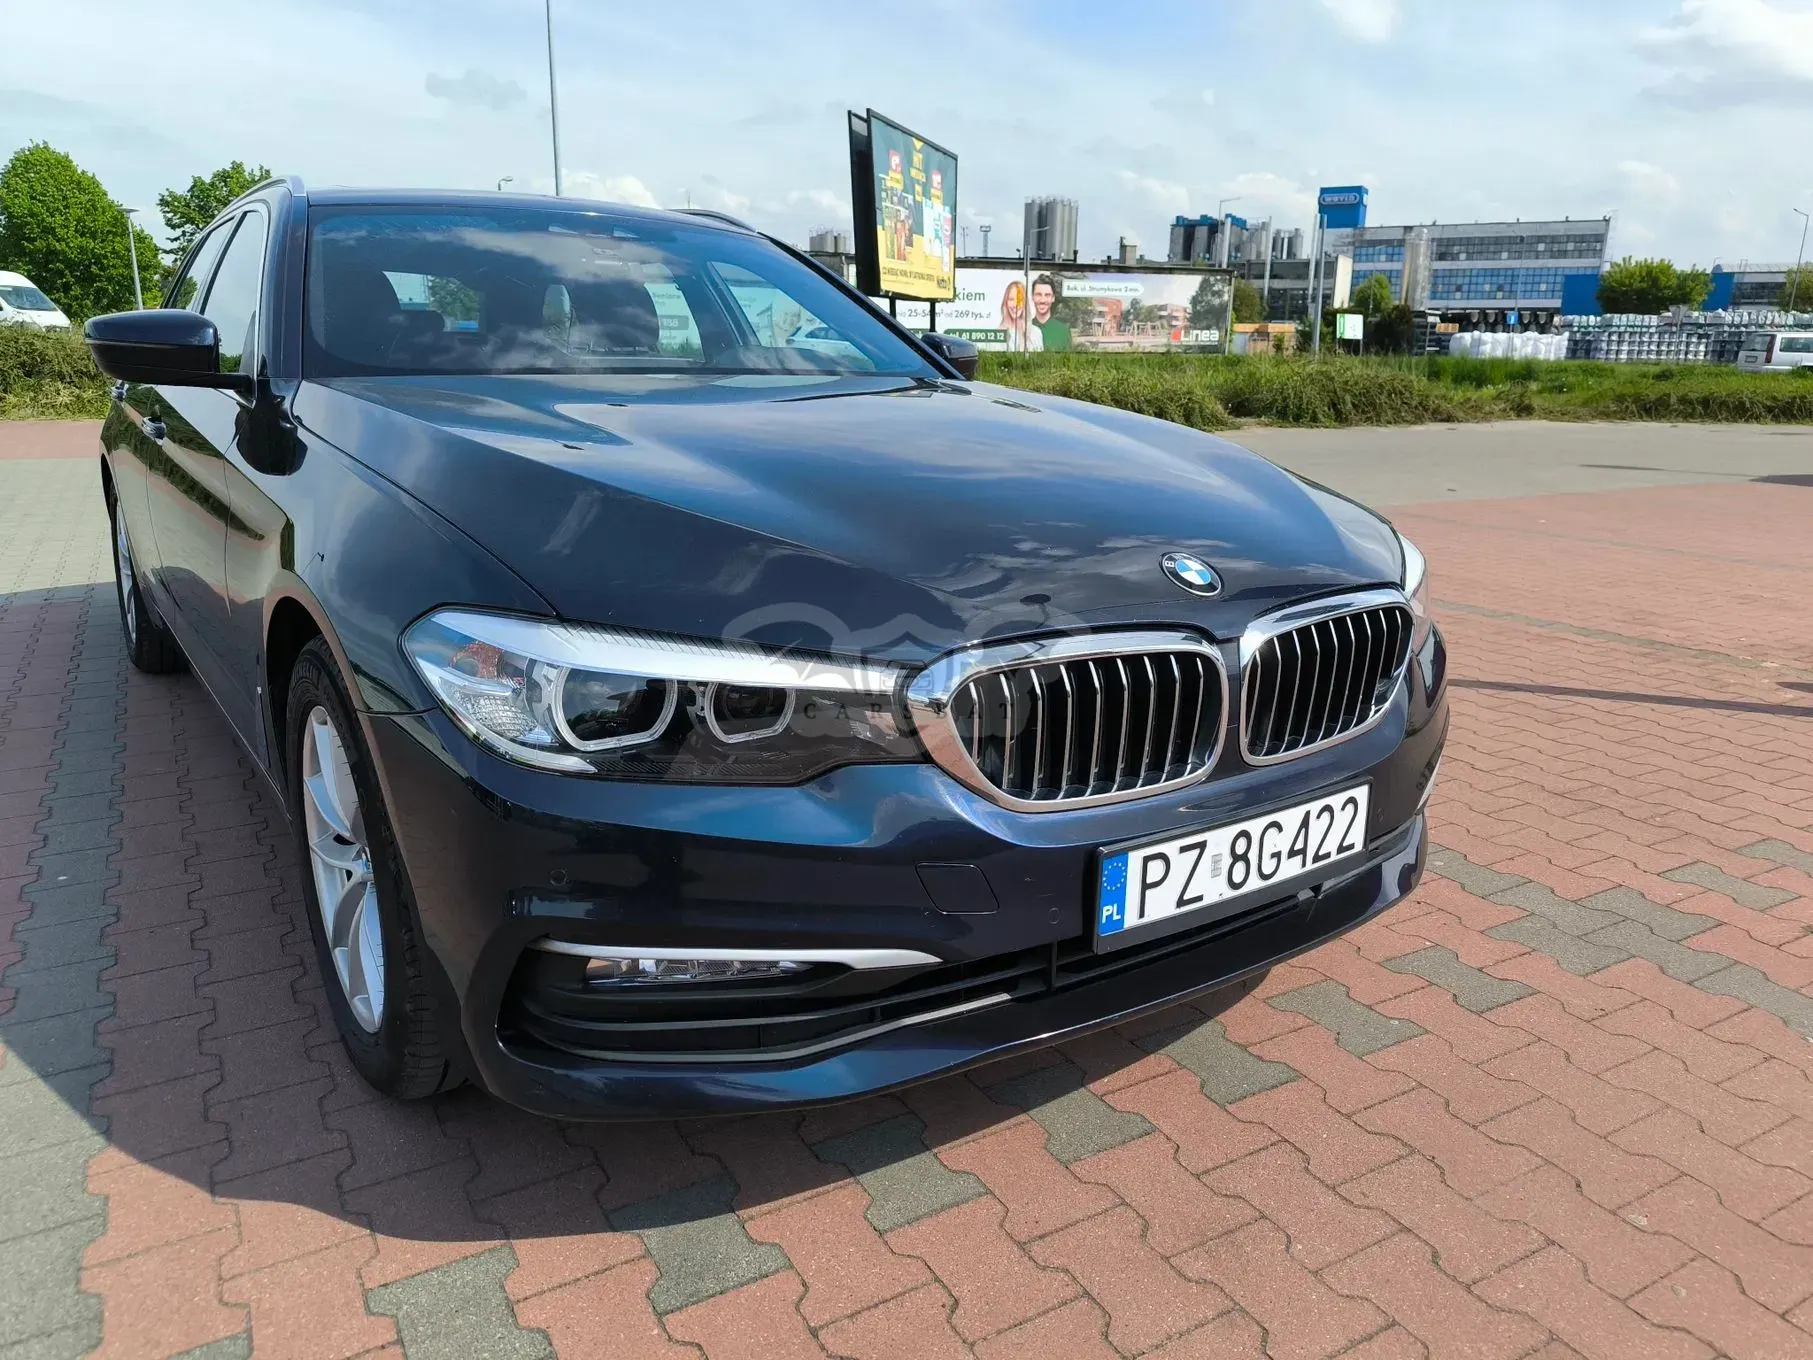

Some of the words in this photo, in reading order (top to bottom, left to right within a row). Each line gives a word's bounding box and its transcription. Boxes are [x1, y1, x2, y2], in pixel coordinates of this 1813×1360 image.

[954, 310, 969, 318] 269
[961, 332, 970, 340] 61
[971, 332, 986, 340] 890
[1137, 839, 1208, 920] PZ
[1226, 795, 1359, 892] 8G422
[1101, 904, 1122, 924] PL
